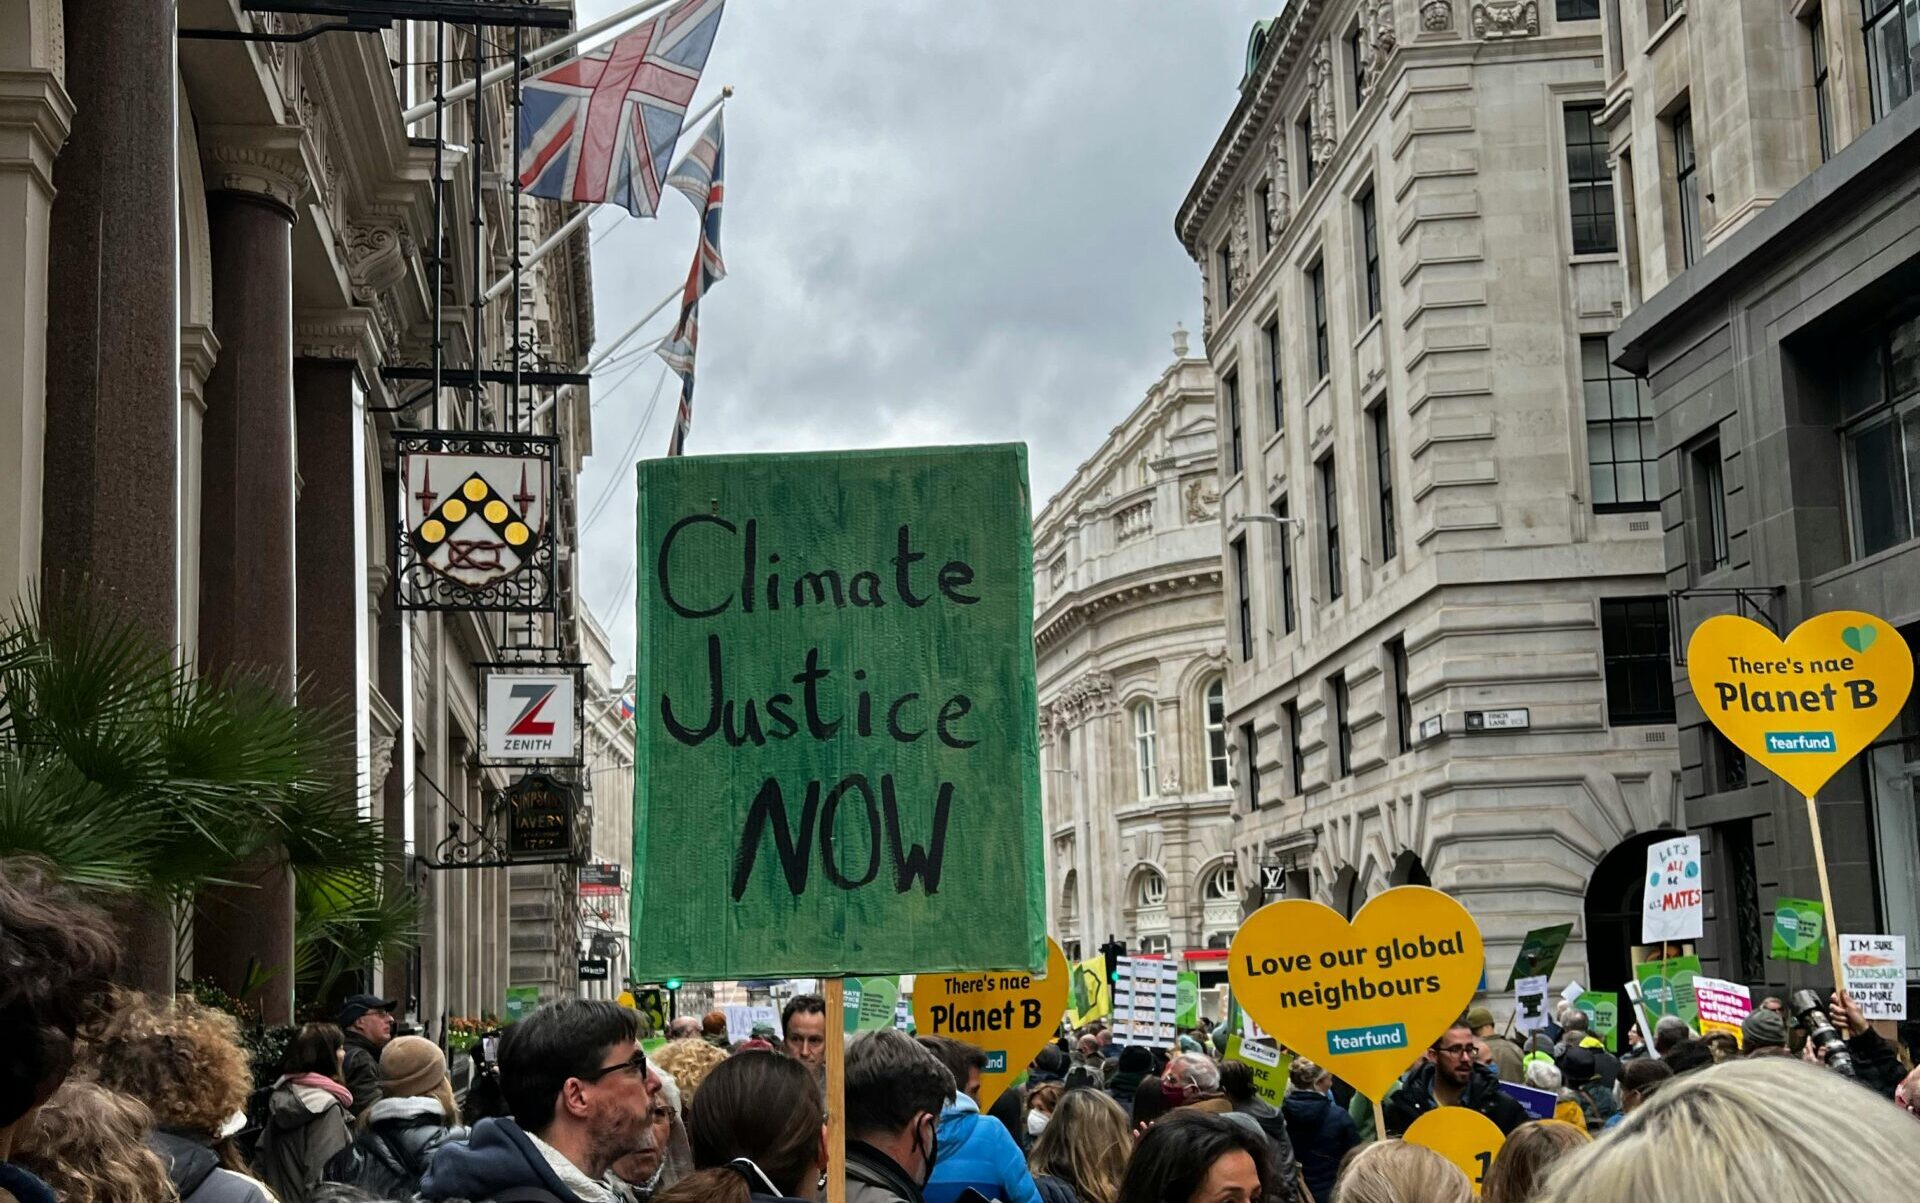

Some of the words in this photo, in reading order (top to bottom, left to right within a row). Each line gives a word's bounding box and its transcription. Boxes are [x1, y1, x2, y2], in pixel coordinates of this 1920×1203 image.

[658, 513, 981, 618] Climate
[1728, 656, 1804, 674] There's
[1810, 657, 1854, 673] nae
[661, 634, 979, 749] Justice
[1714, 682, 1837, 713] Planet
[1844, 679, 1878, 710] B
[504, 740, 552, 750] ZENITH
[1769, 736, 1830, 750] tearfund
[514, 815, 564, 829] TAVERN
[731, 773, 955, 902] NOW
[1667, 860, 1683, 872] ALL
[1246, 952, 1312, 977] Love
[1320, 948, 1367, 969] our
[1375, 931, 1464, 969] global
[1873, 940, 1894, 951] SURE
[1848, 968, 1904, 979] DINOSAURS
[944, 974, 995, 994] There's
[1000, 976, 1030, 990] nae
[1280, 975, 1440, 1010] neighbours
[1698, 989, 1743, 1007] Climate
[1869, 991, 1893, 1001] MORE
[930, 1000, 1015, 1033] Planet
[1020, 999, 1041, 1028] B
[1884, 1003, 1902, 1014] TOO
[1702, 1011, 1744, 1027] welcom
[1332, 1028, 1401, 1050] tearfund
